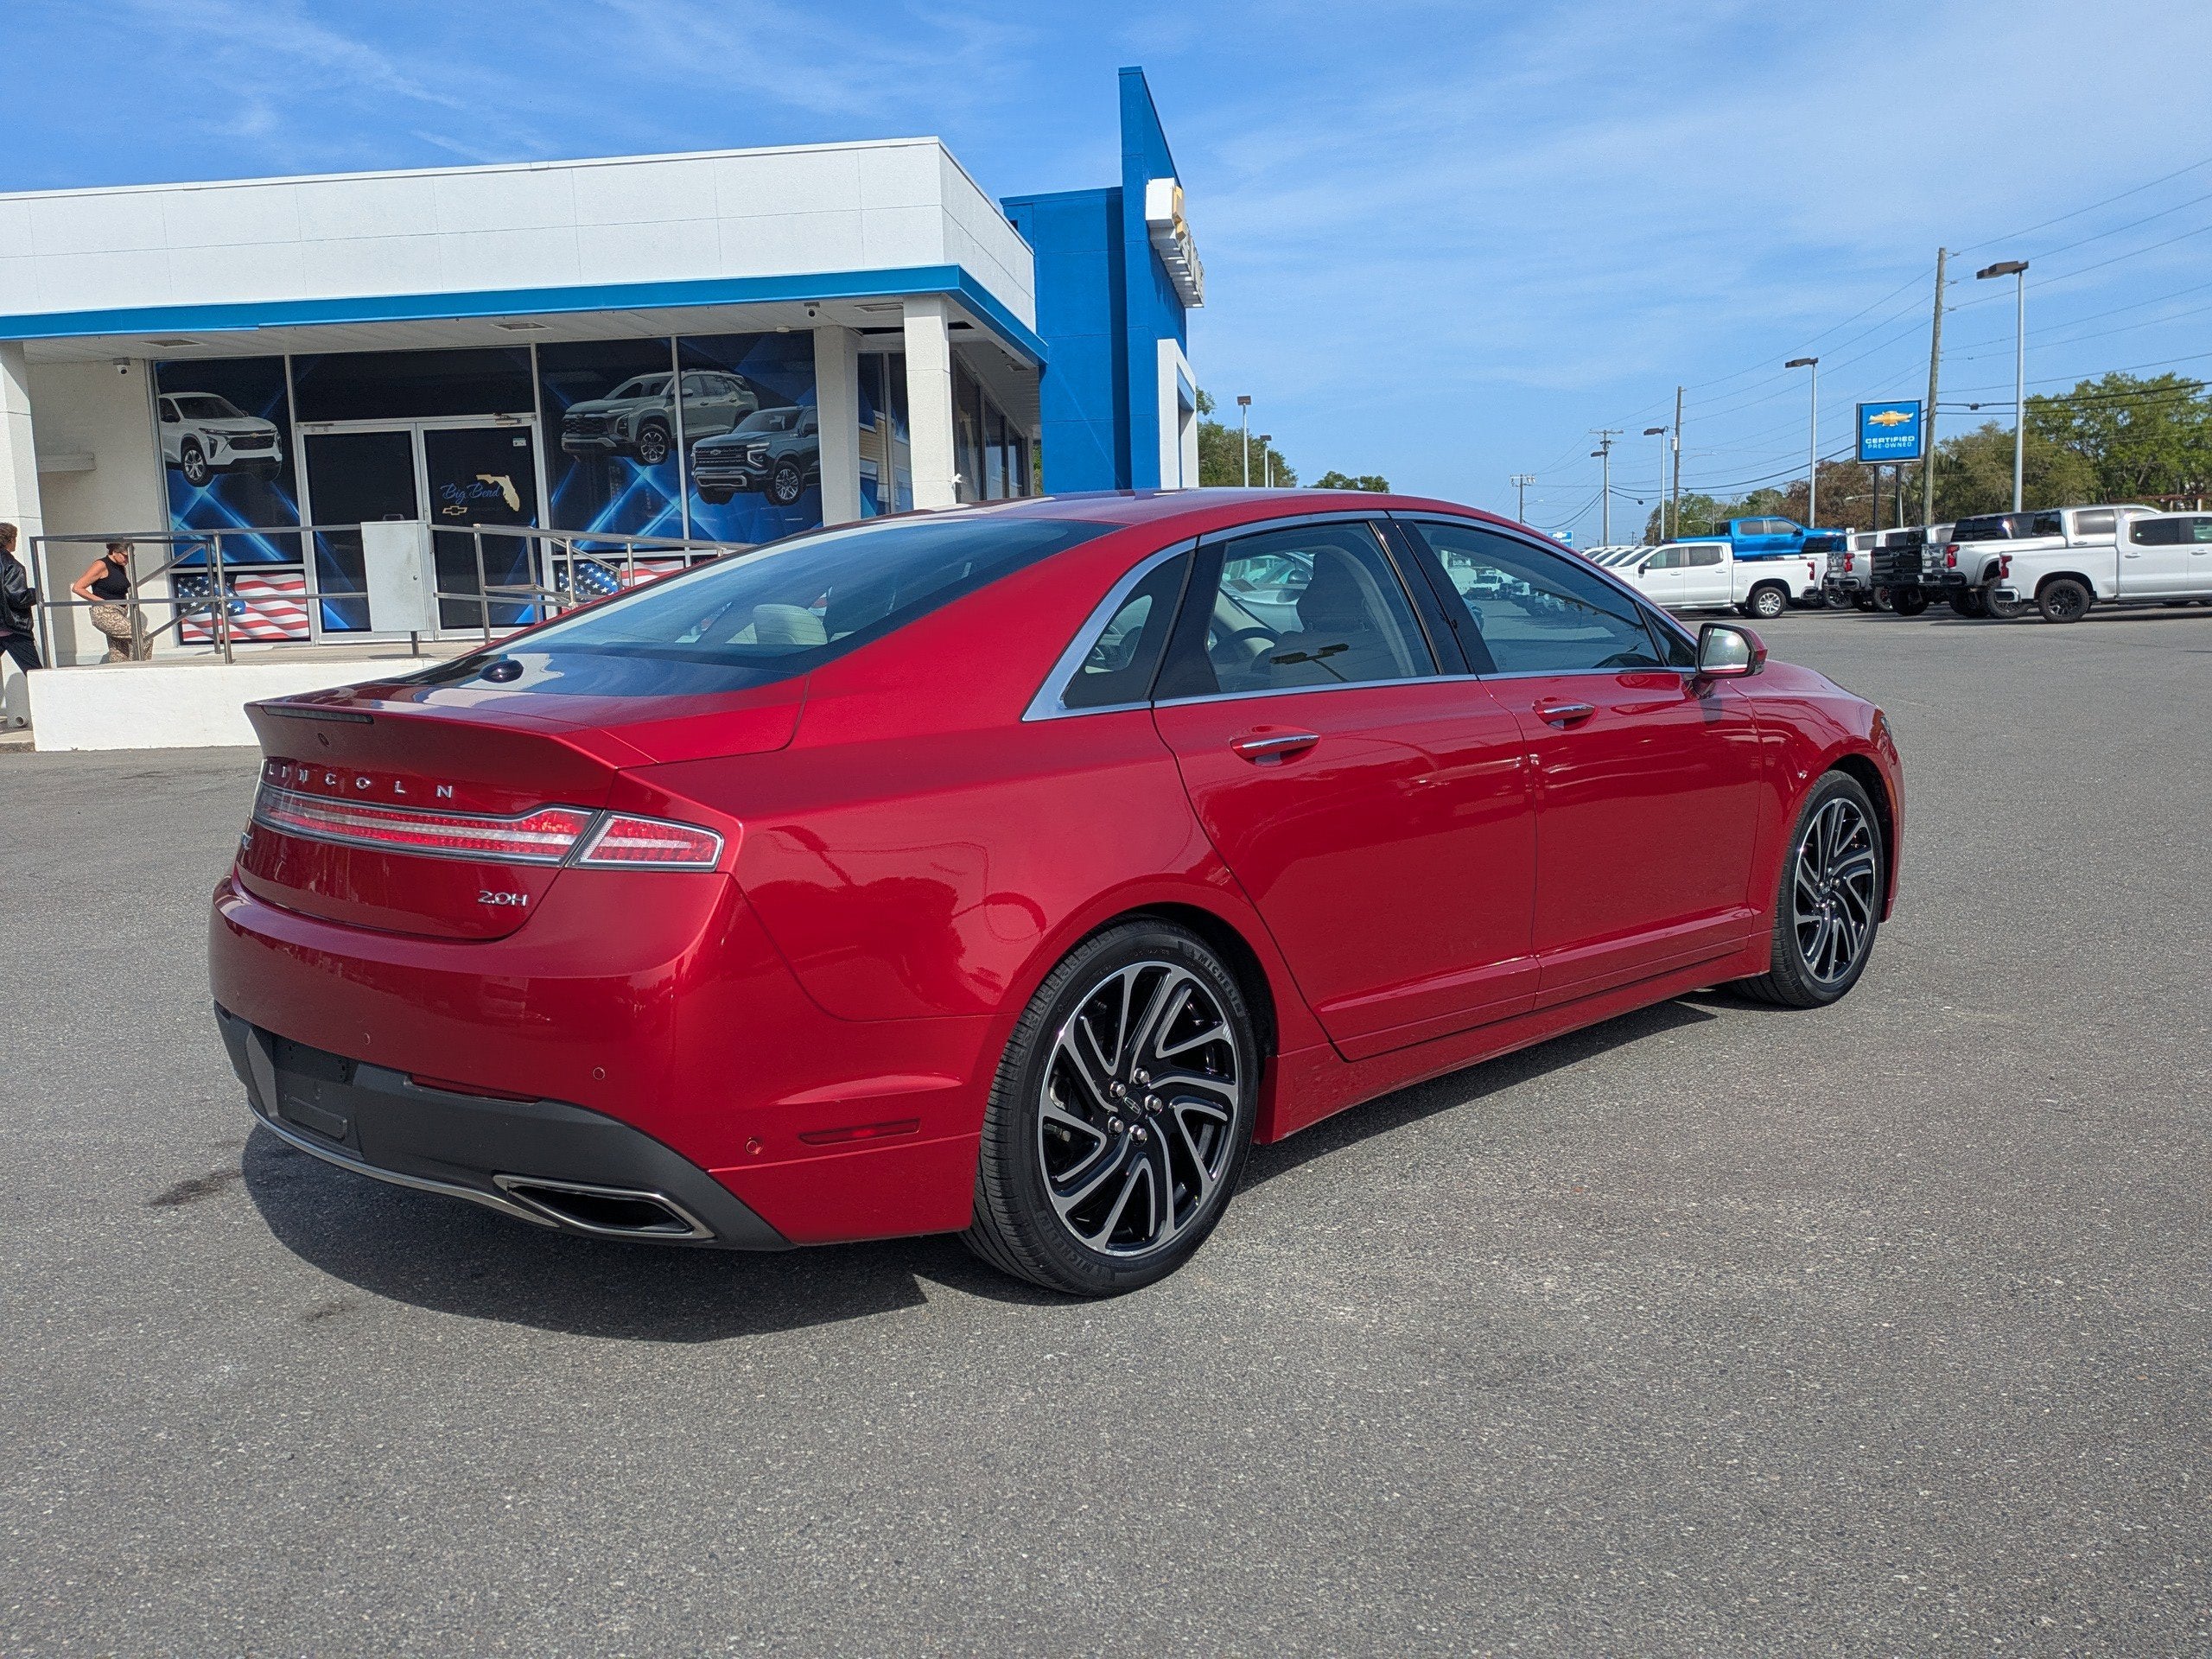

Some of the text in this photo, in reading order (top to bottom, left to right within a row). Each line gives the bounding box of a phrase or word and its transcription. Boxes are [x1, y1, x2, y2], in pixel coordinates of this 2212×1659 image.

[1865, 435, 1916, 444] CERTIFIED
[440, 482, 501, 505] Big Bend
[268, 763, 453, 798] LINCOLN
[1197, 952, 1243, 1013] MICHELIN
